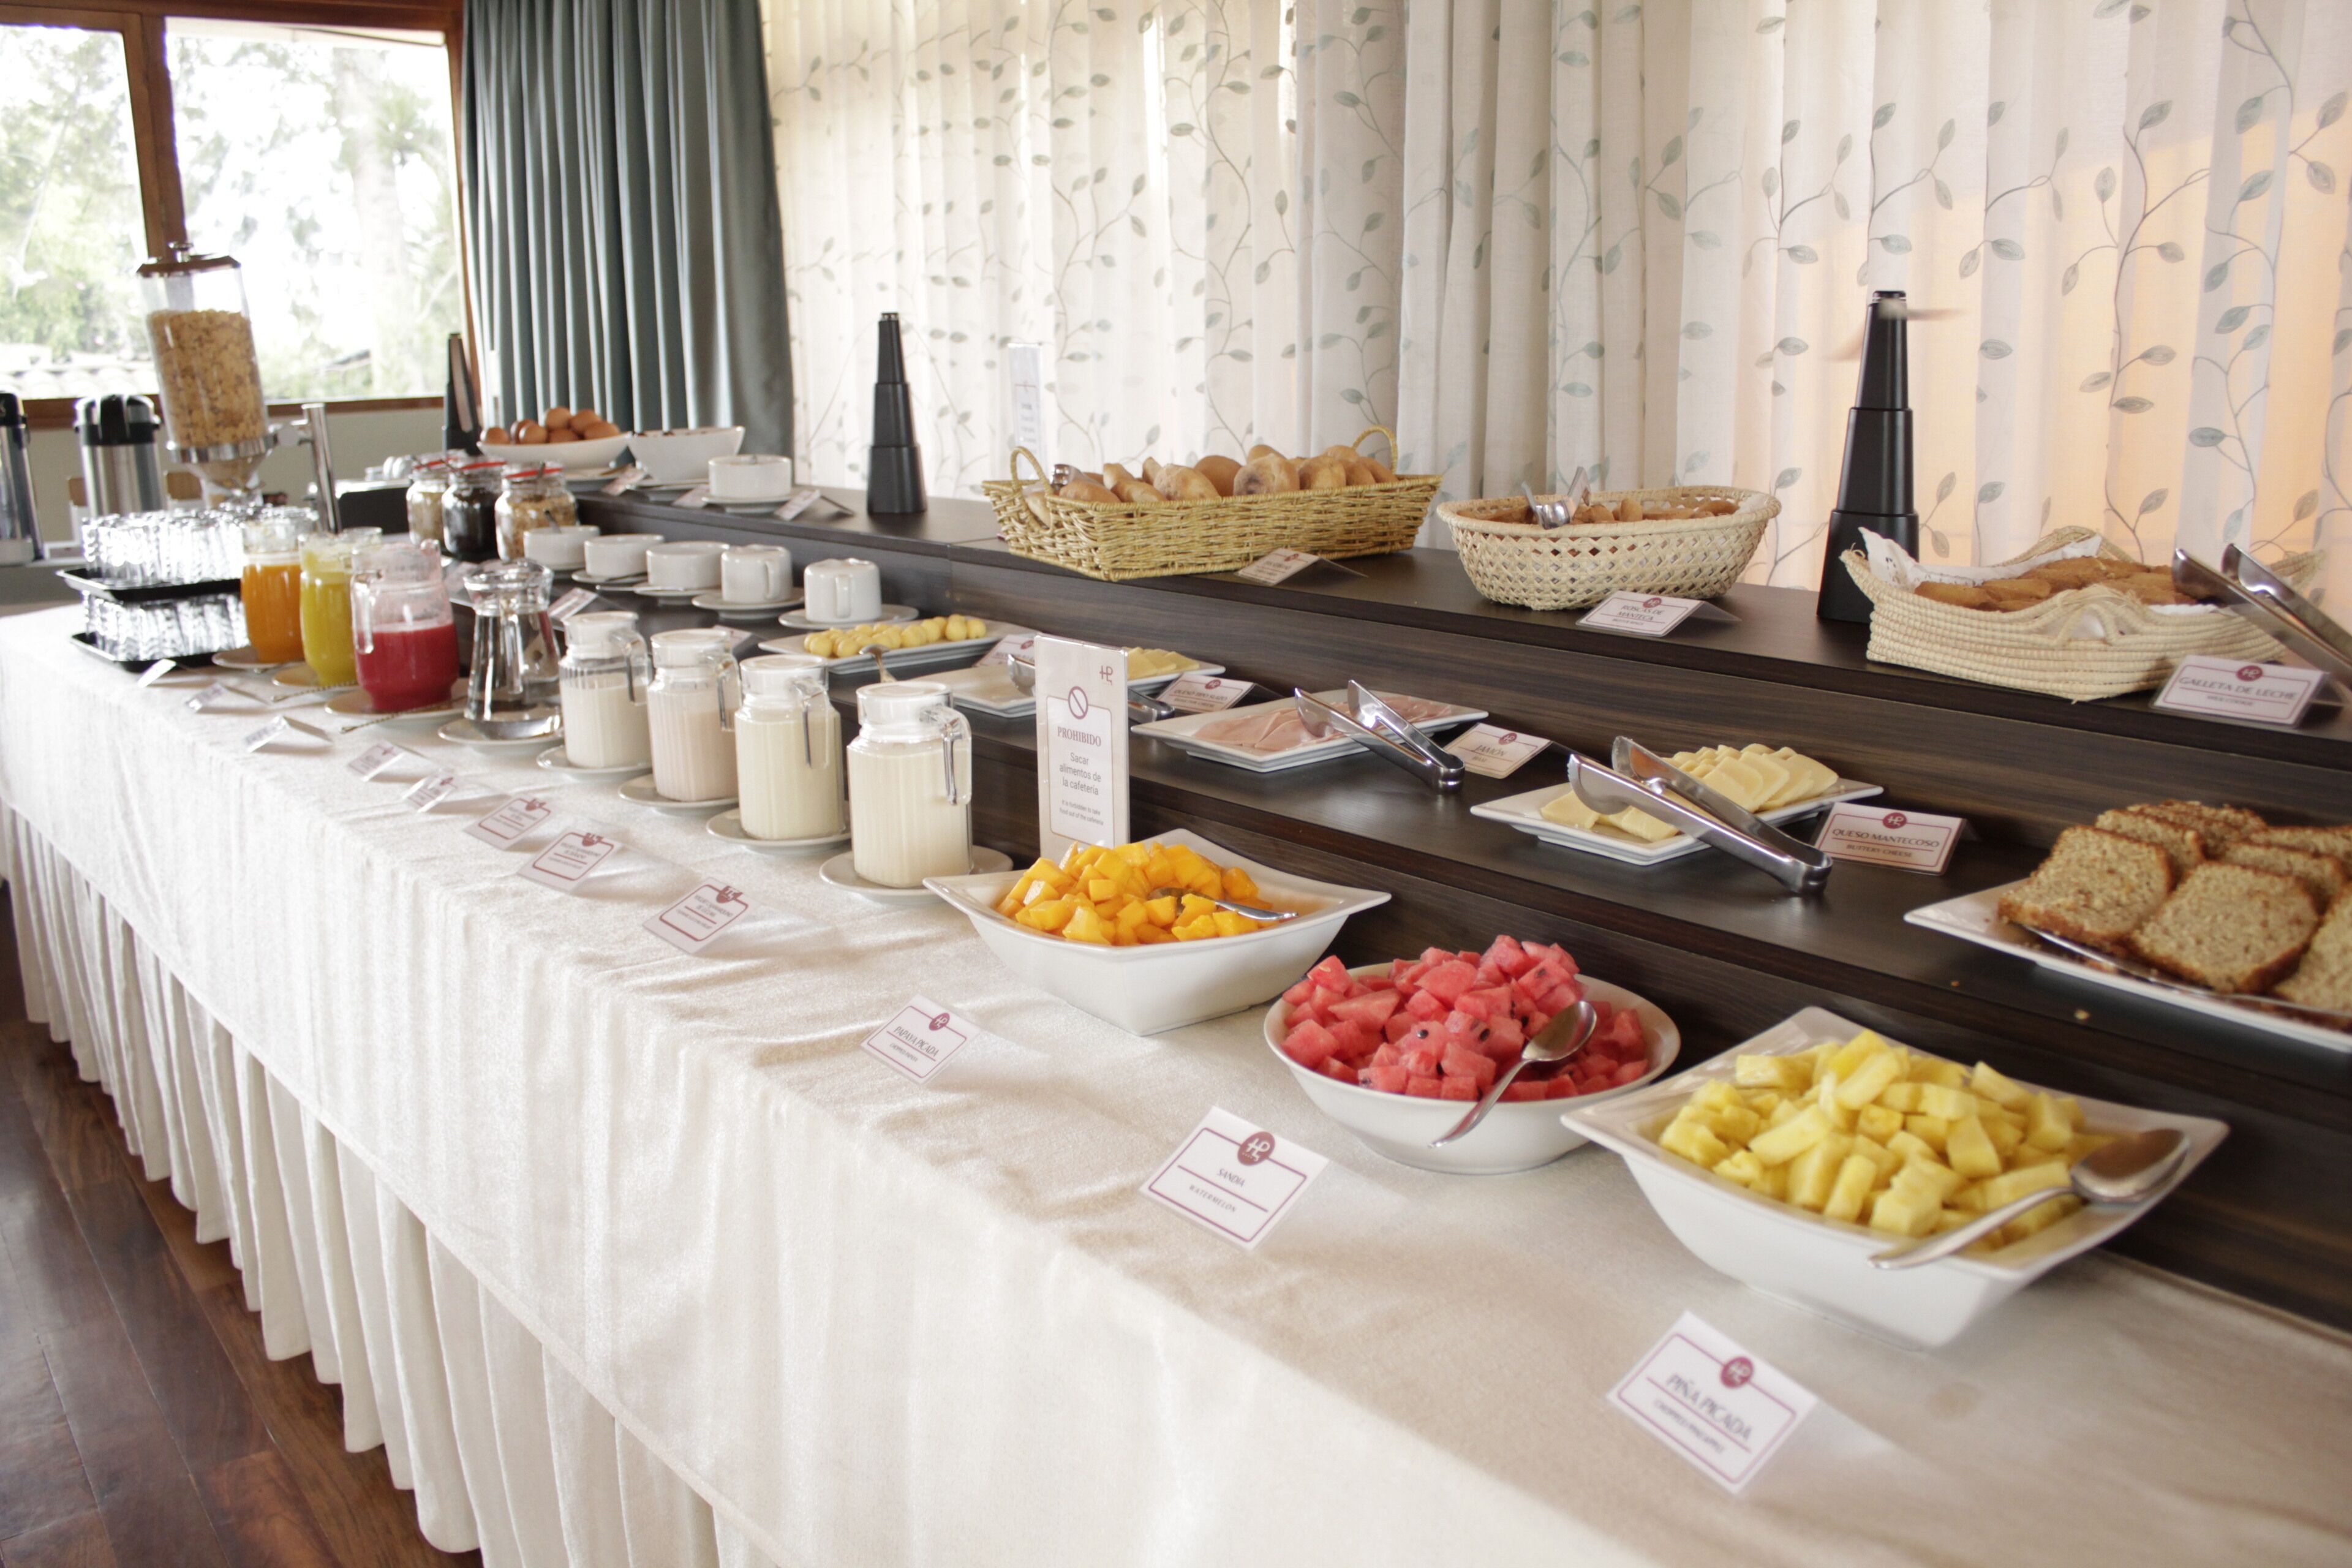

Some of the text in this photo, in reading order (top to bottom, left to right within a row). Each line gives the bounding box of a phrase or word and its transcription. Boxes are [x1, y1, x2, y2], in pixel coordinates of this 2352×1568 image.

[2179, 676, 2296, 701] GALLETA DE LECHE
[1057, 726, 1102, 747] PROHIBIDO
[1070, 752, 1089, 765] Sacar
[1059, 763, 1101, 783] alimentos de
[1062, 776, 1099, 796] la cafetería
[1832, 828, 1940, 848] QUESO MANTECOSO
[1882, 848, 1913, 858] CHEESE
[893, 1025, 940, 1057] PAPAYA PICADA
[1216, 1167, 1246, 1188] SANDIA
[1188, 1184, 1237, 1213] WATERMELON
[1700, 1396, 1752, 1441] PICADA
